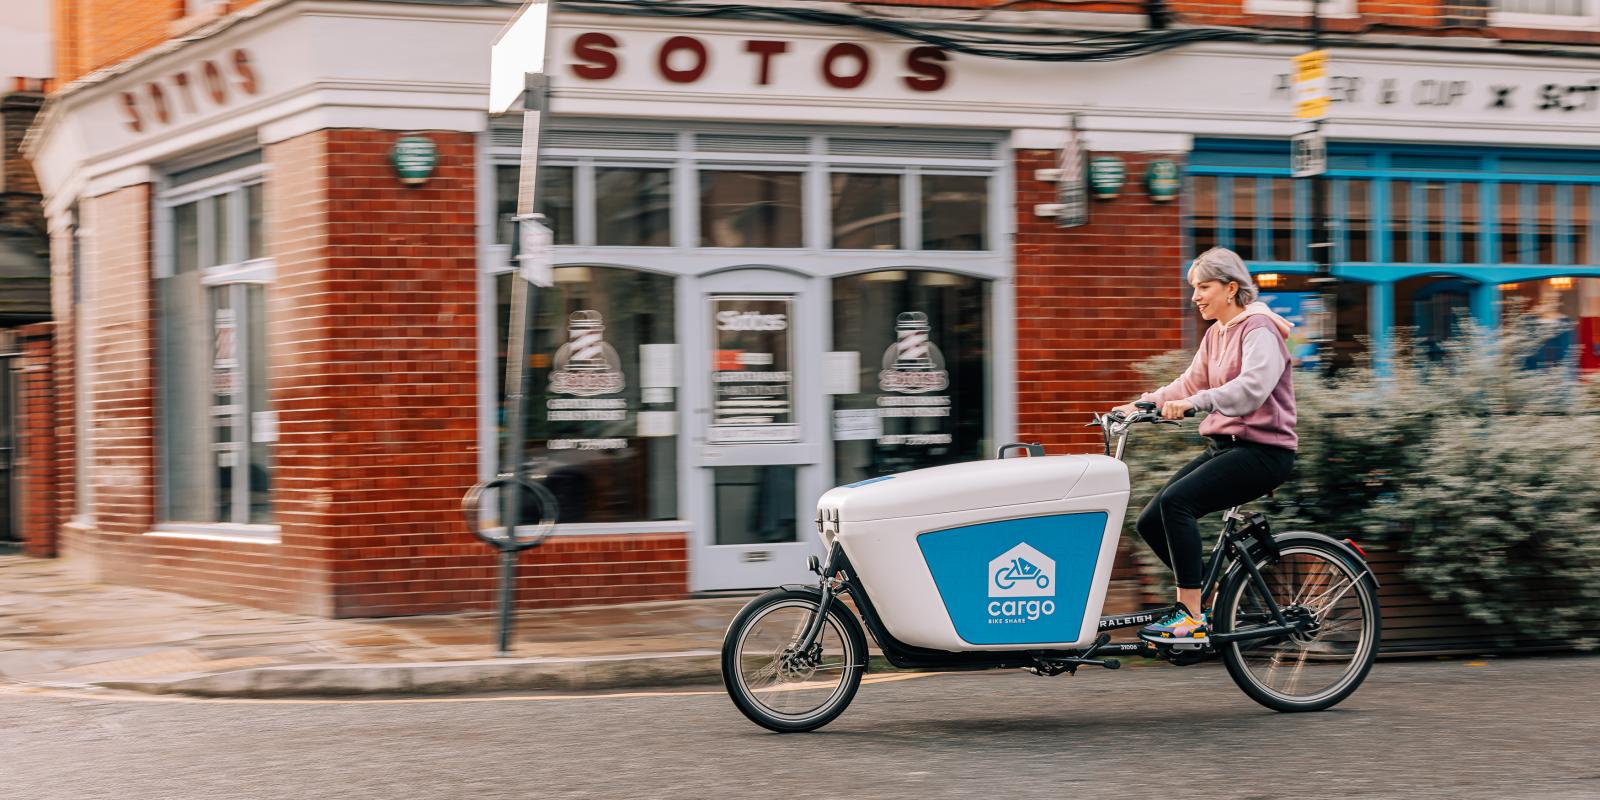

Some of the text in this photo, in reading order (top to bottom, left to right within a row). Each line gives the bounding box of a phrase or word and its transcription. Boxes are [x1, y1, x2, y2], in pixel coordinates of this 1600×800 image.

[568, 31, 952, 93] SOTOS
[119, 48, 259, 133] SOTOS
[987, 600, 1056, 621] cargo
[1099, 614, 1153, 628] RALEIGH
